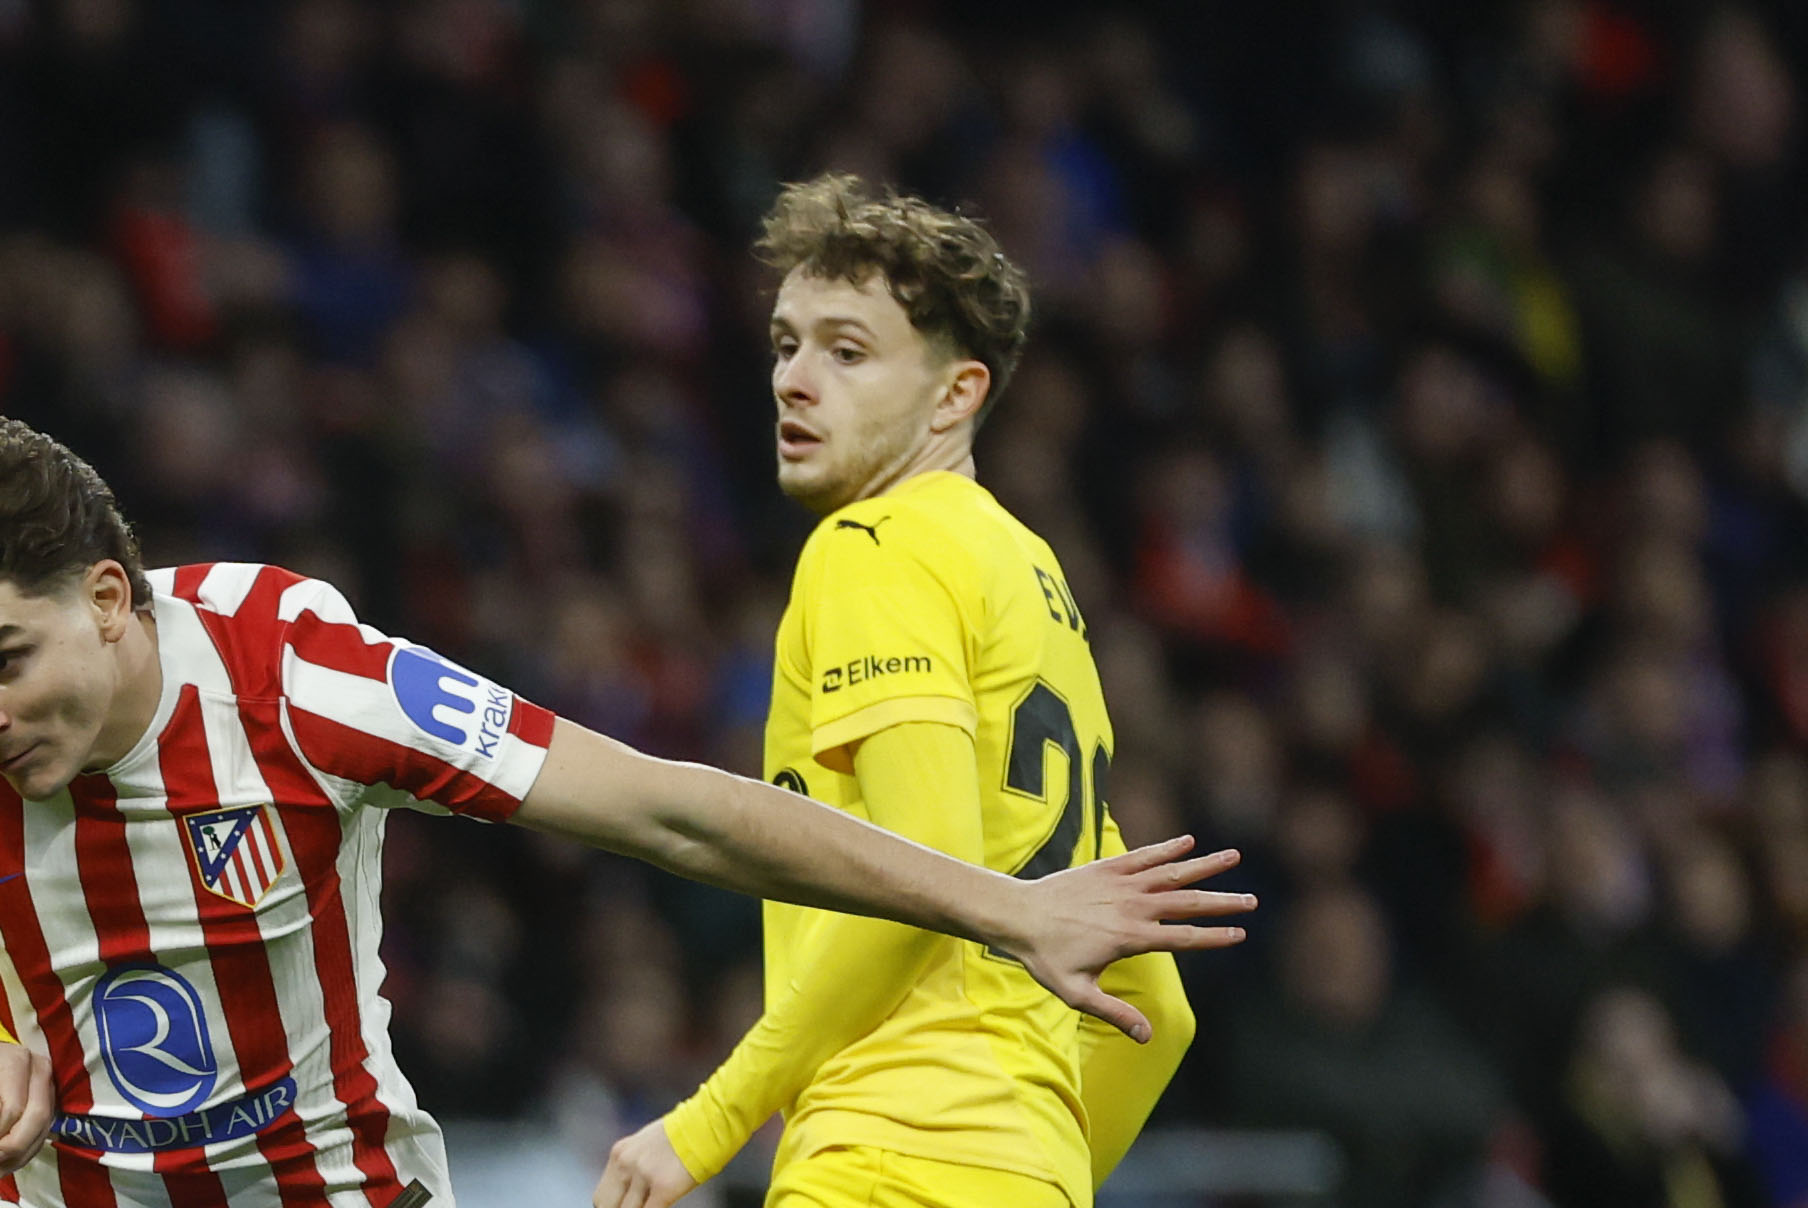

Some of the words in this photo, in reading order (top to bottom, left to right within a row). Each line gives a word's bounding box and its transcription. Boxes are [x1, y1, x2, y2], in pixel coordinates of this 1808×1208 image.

[848, 655, 931, 686] Elkem
[60, 1111, 212, 1149] RIYADH
[227, 1086, 291, 1135] AIR
